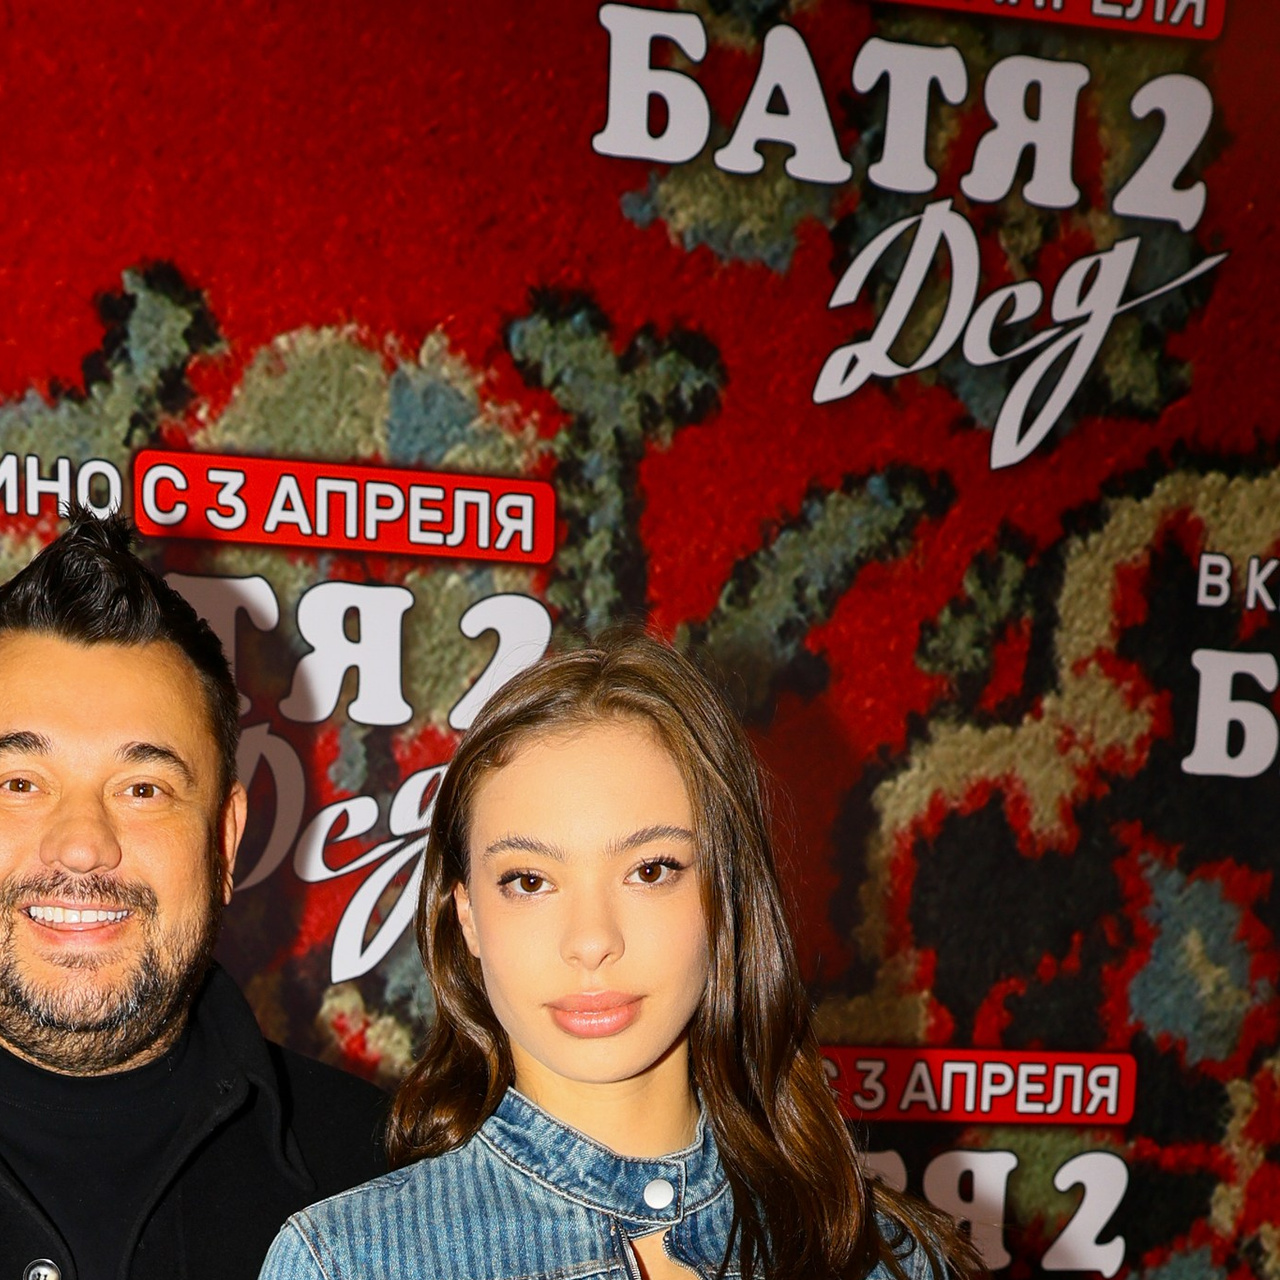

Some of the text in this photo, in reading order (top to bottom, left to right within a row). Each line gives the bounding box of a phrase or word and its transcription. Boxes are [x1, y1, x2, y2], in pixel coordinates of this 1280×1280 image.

[592, 3, 1215, 232] БАТЯ 2
[142, 464, 188, 526] С
[205, 469, 248, 531] 3
[263, 474, 534, 553] АПРЕЛЯ
[1197, 553, 1231, 607] В
[852, 1060, 887, 1110] 3
[898, 1060, 1120, 1115] АПРЕЛЯ
[1041, 1151, 1129, 1279] 2
